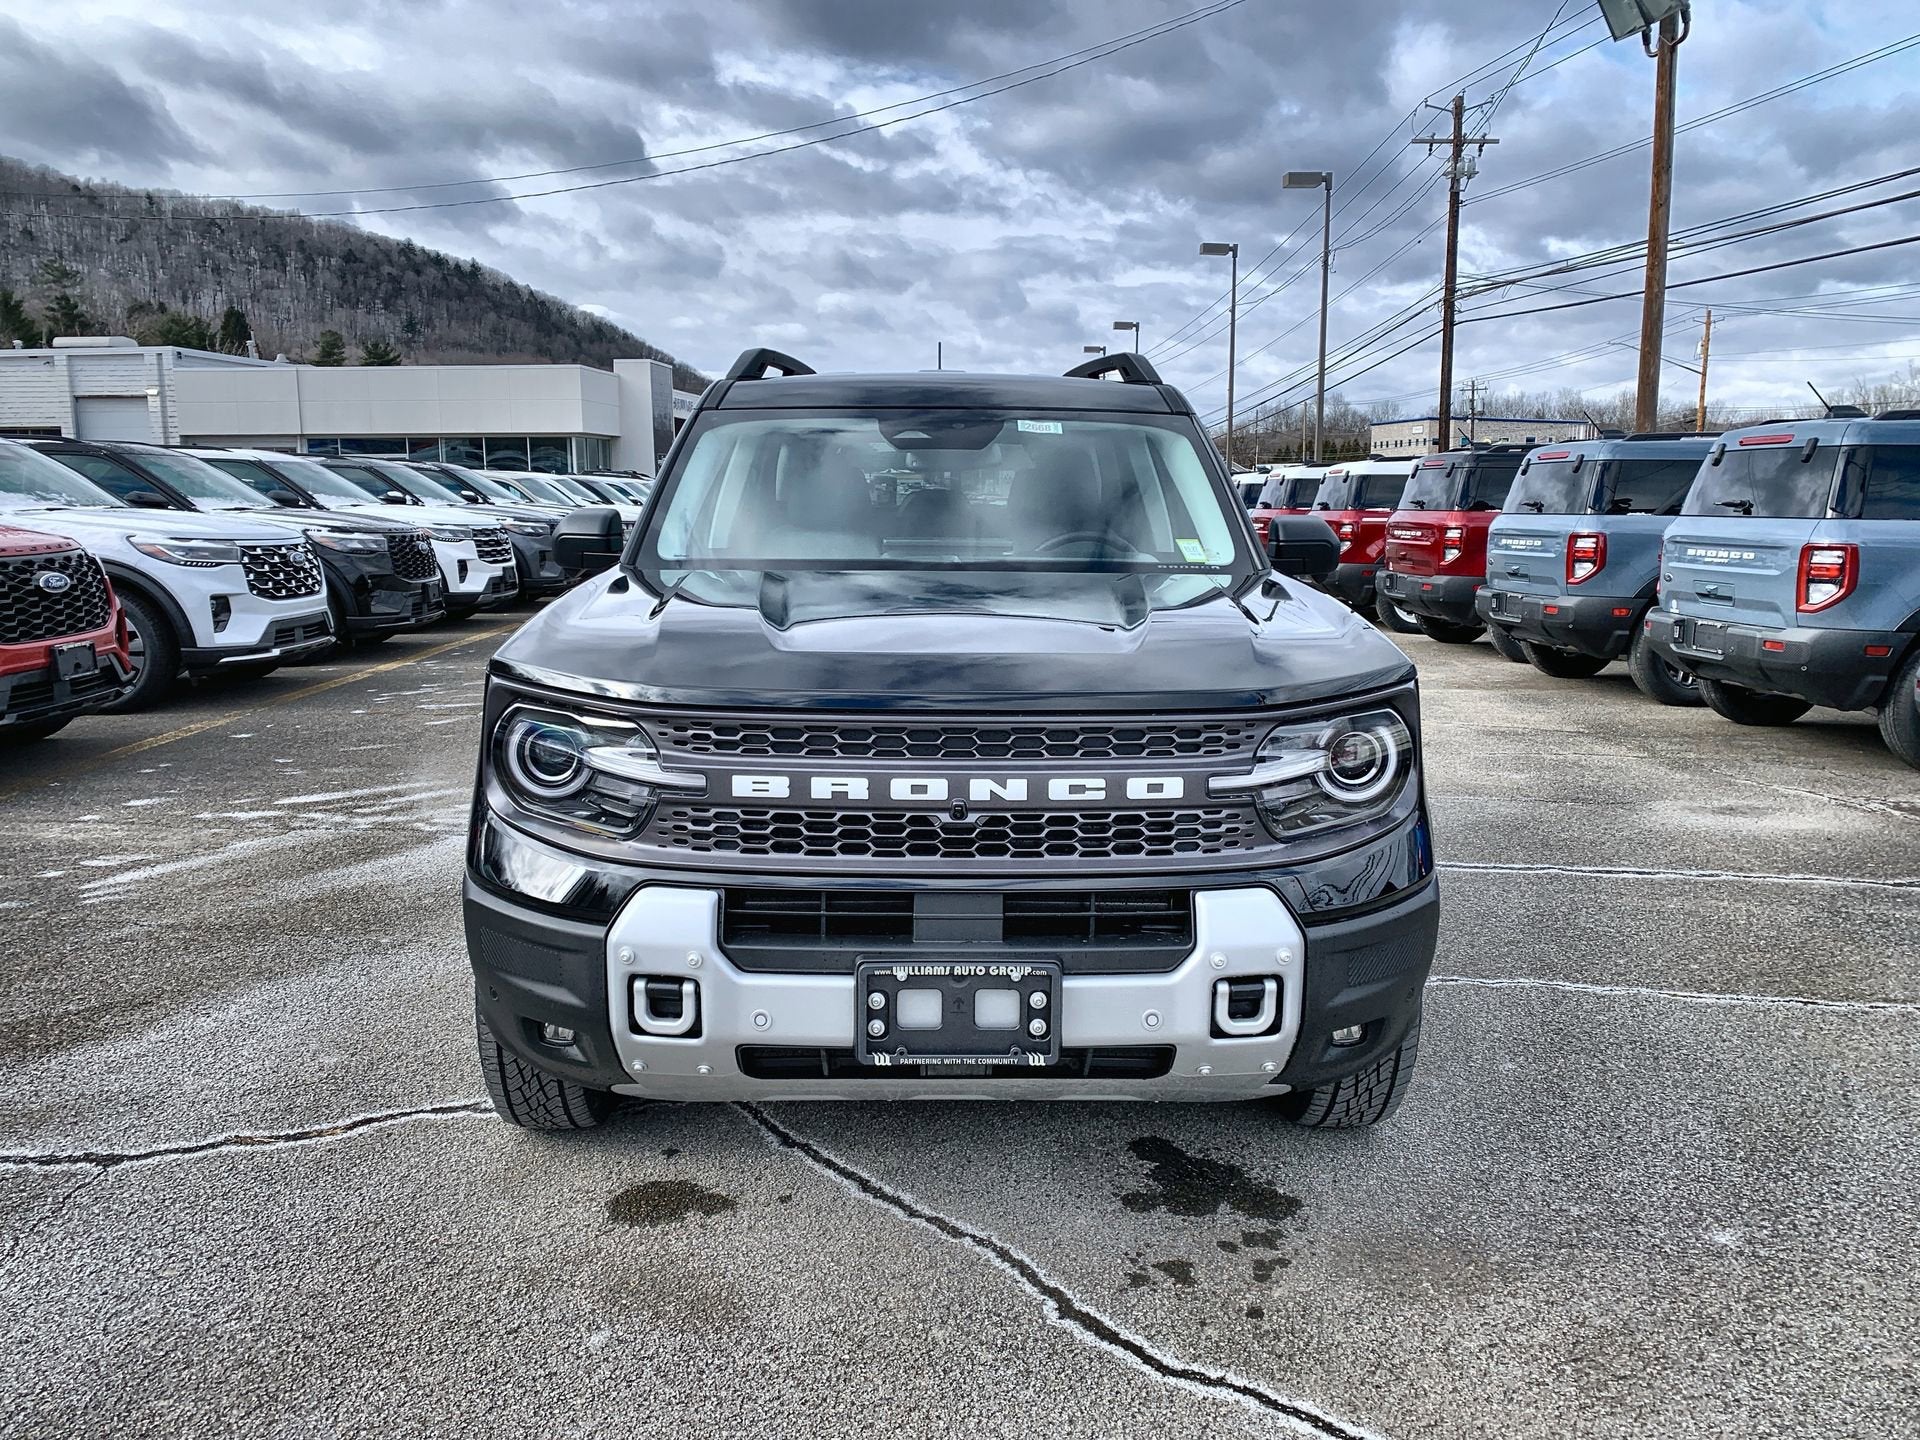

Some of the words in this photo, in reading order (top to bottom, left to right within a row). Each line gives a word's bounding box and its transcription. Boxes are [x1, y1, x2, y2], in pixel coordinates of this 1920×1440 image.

[1501, 538, 1542, 546] BRONCO
[1686, 548, 1756, 560] BRONCO
[731, 774, 1185, 801] BRONCO
[953, 965, 986, 976] AUTO
